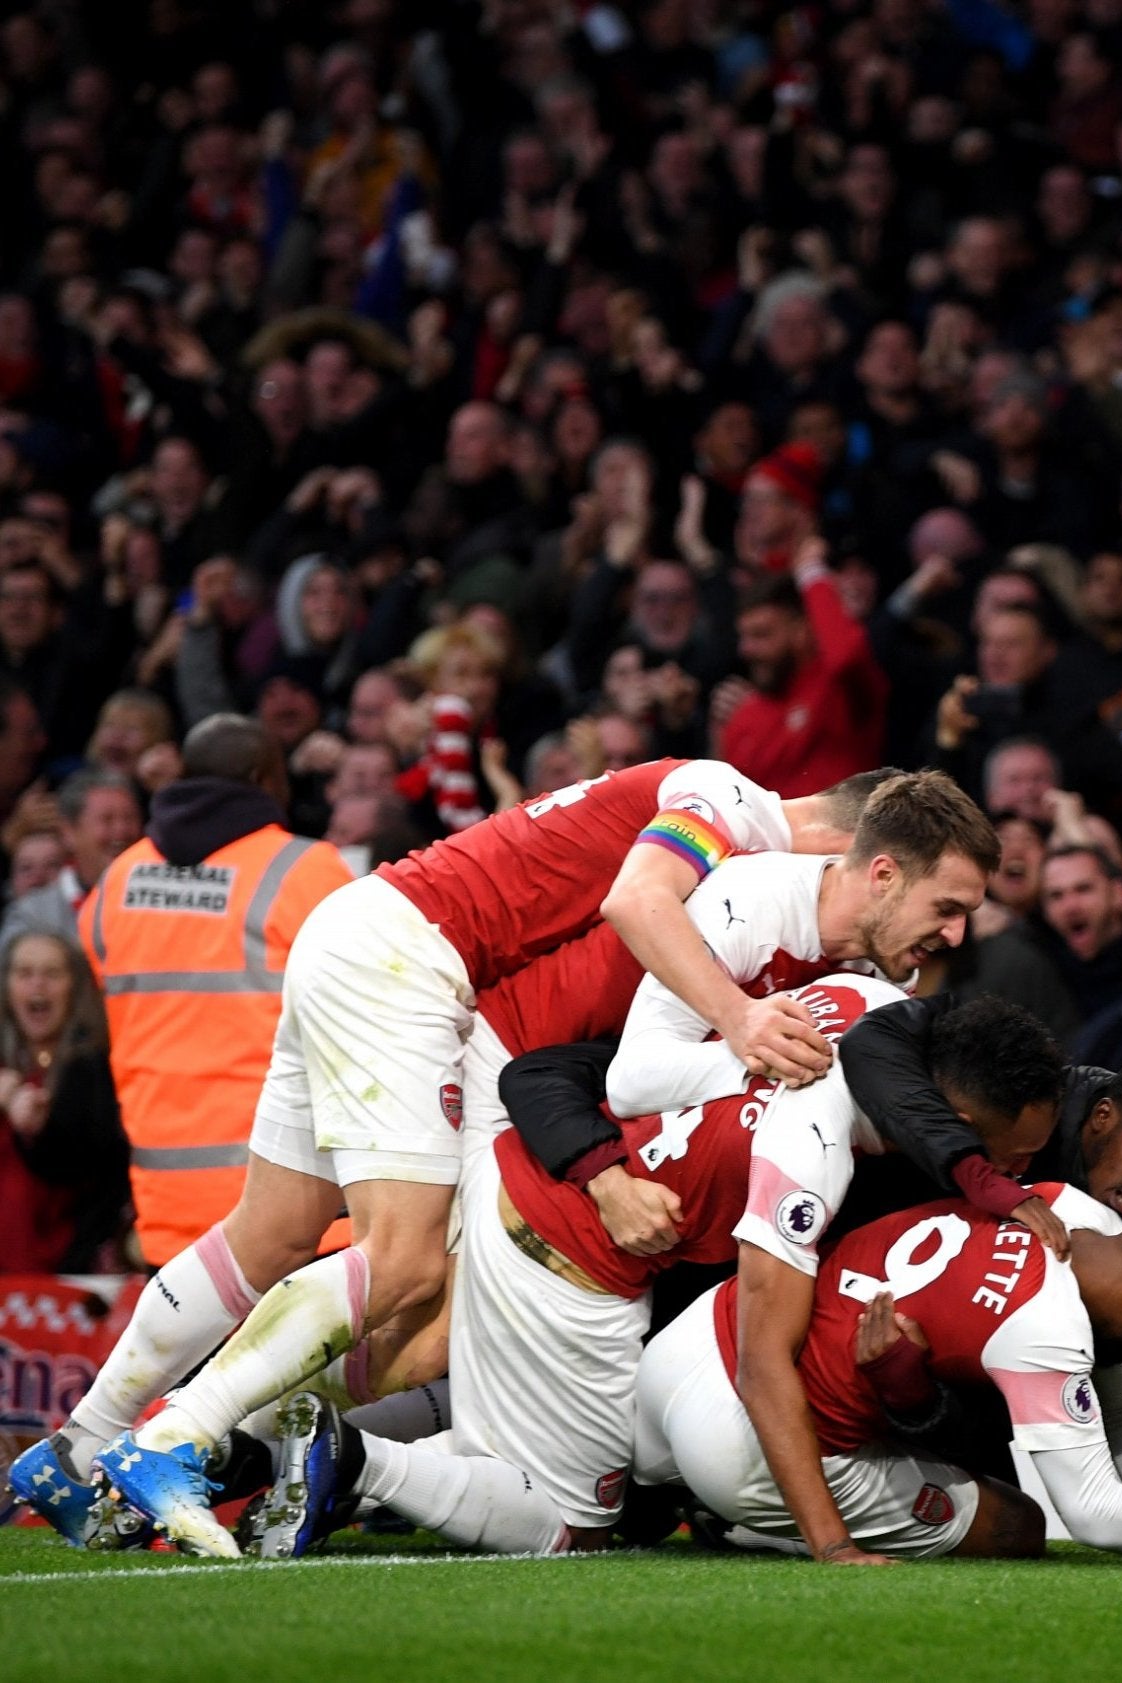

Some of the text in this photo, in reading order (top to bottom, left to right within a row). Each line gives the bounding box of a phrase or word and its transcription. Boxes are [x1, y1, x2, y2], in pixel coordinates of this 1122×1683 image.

[125, 888, 228, 913] STEWARD
[838, 1213, 971, 1304] 9
[971, 1222, 1032, 1315] ETTE
